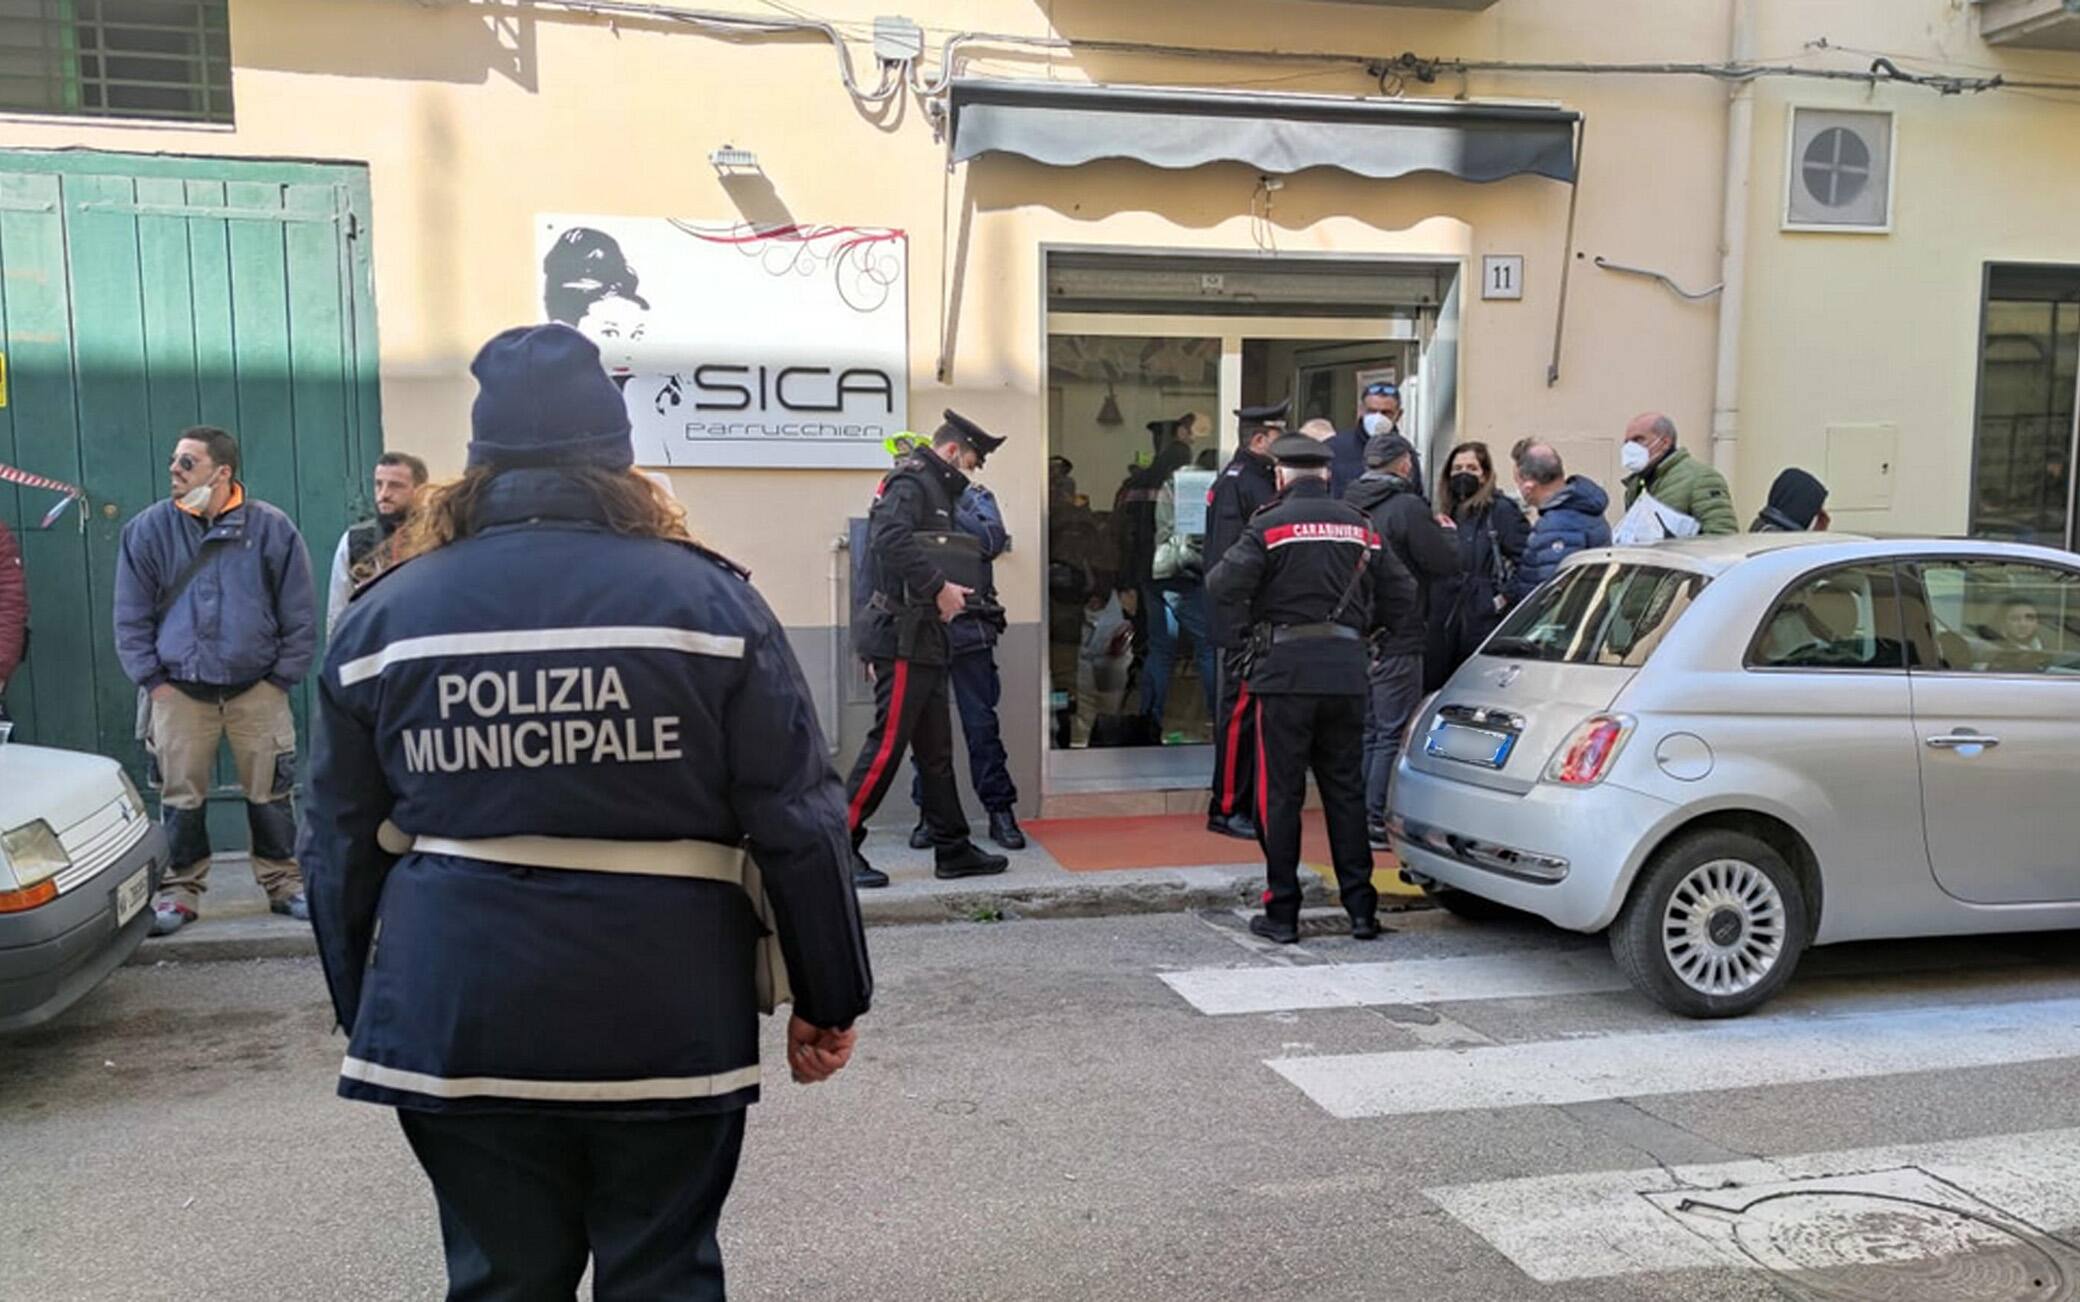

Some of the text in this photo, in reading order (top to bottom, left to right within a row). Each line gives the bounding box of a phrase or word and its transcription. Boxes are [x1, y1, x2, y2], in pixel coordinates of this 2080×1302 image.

[1494, 265, 1510, 289] 11
[694, 364, 893, 413] SICA
[685, 421, 883, 440] Parrucchieri
[1292, 523, 1364, 538] CARABINIERI
[438, 666, 630, 719] POLIZIA
[402, 716, 682, 773] MUNICIPALE
